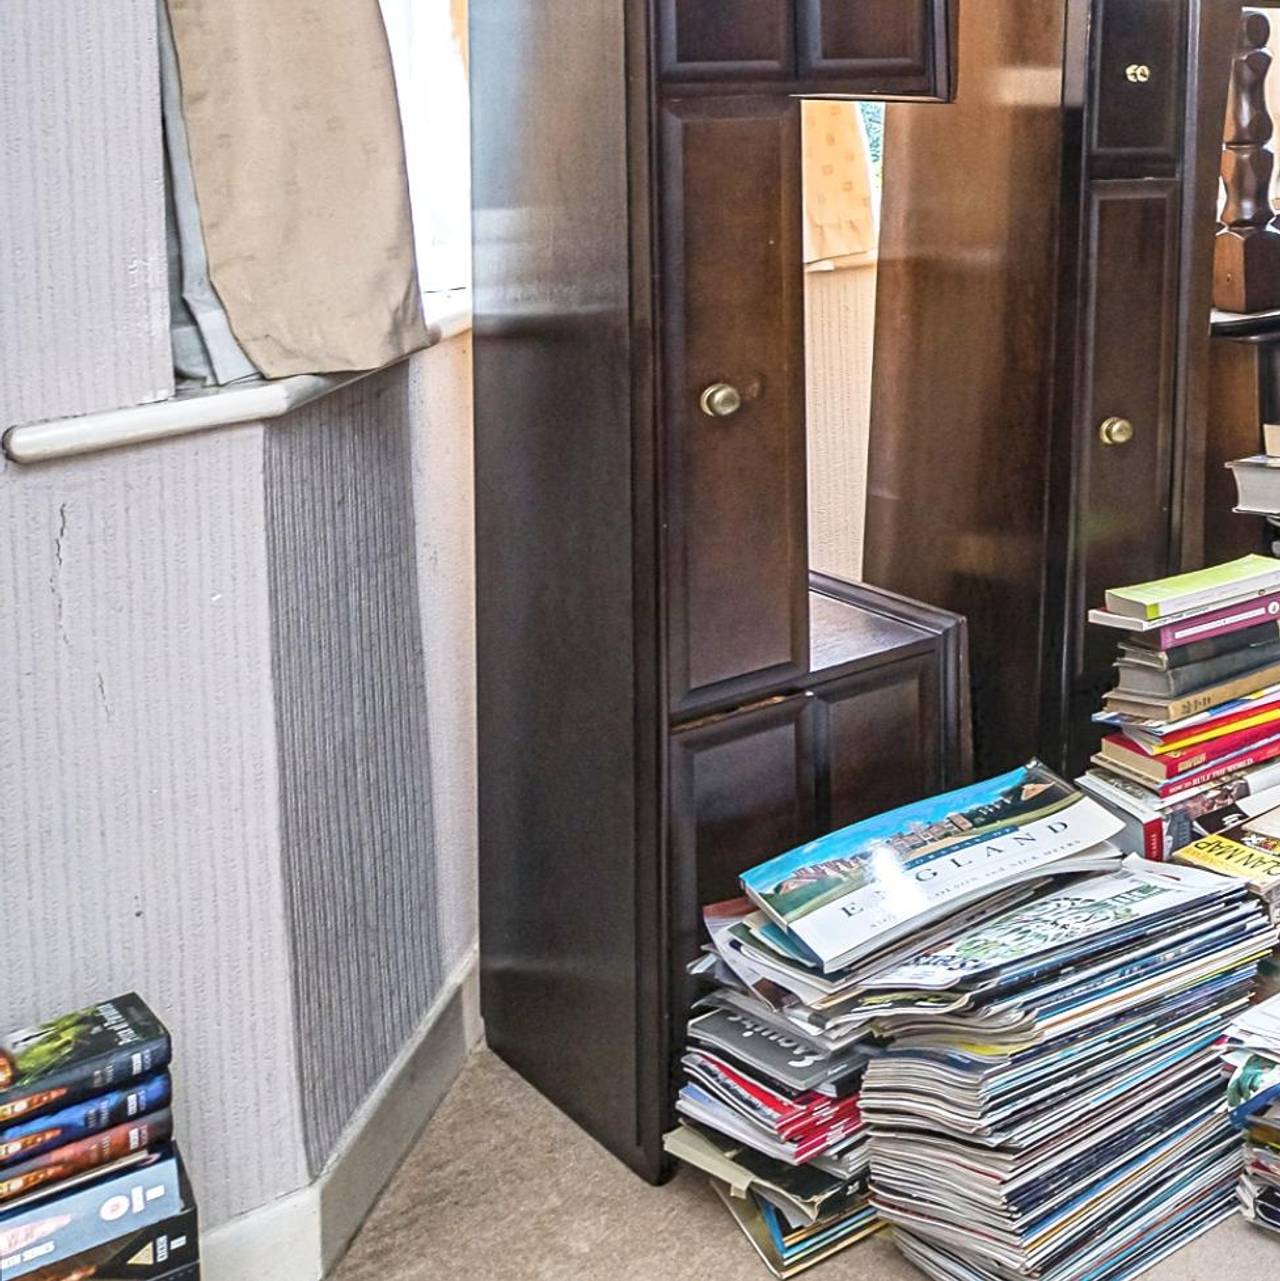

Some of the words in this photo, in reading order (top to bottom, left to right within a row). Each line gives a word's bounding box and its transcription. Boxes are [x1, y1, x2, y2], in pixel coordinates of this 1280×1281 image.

[1191, 773, 1211, 786] RULE
[1225, 757, 1254, 773] WORLD
[1194, 838, 1239, 861] MAP
[840, 820, 1069, 919] EGLAND
